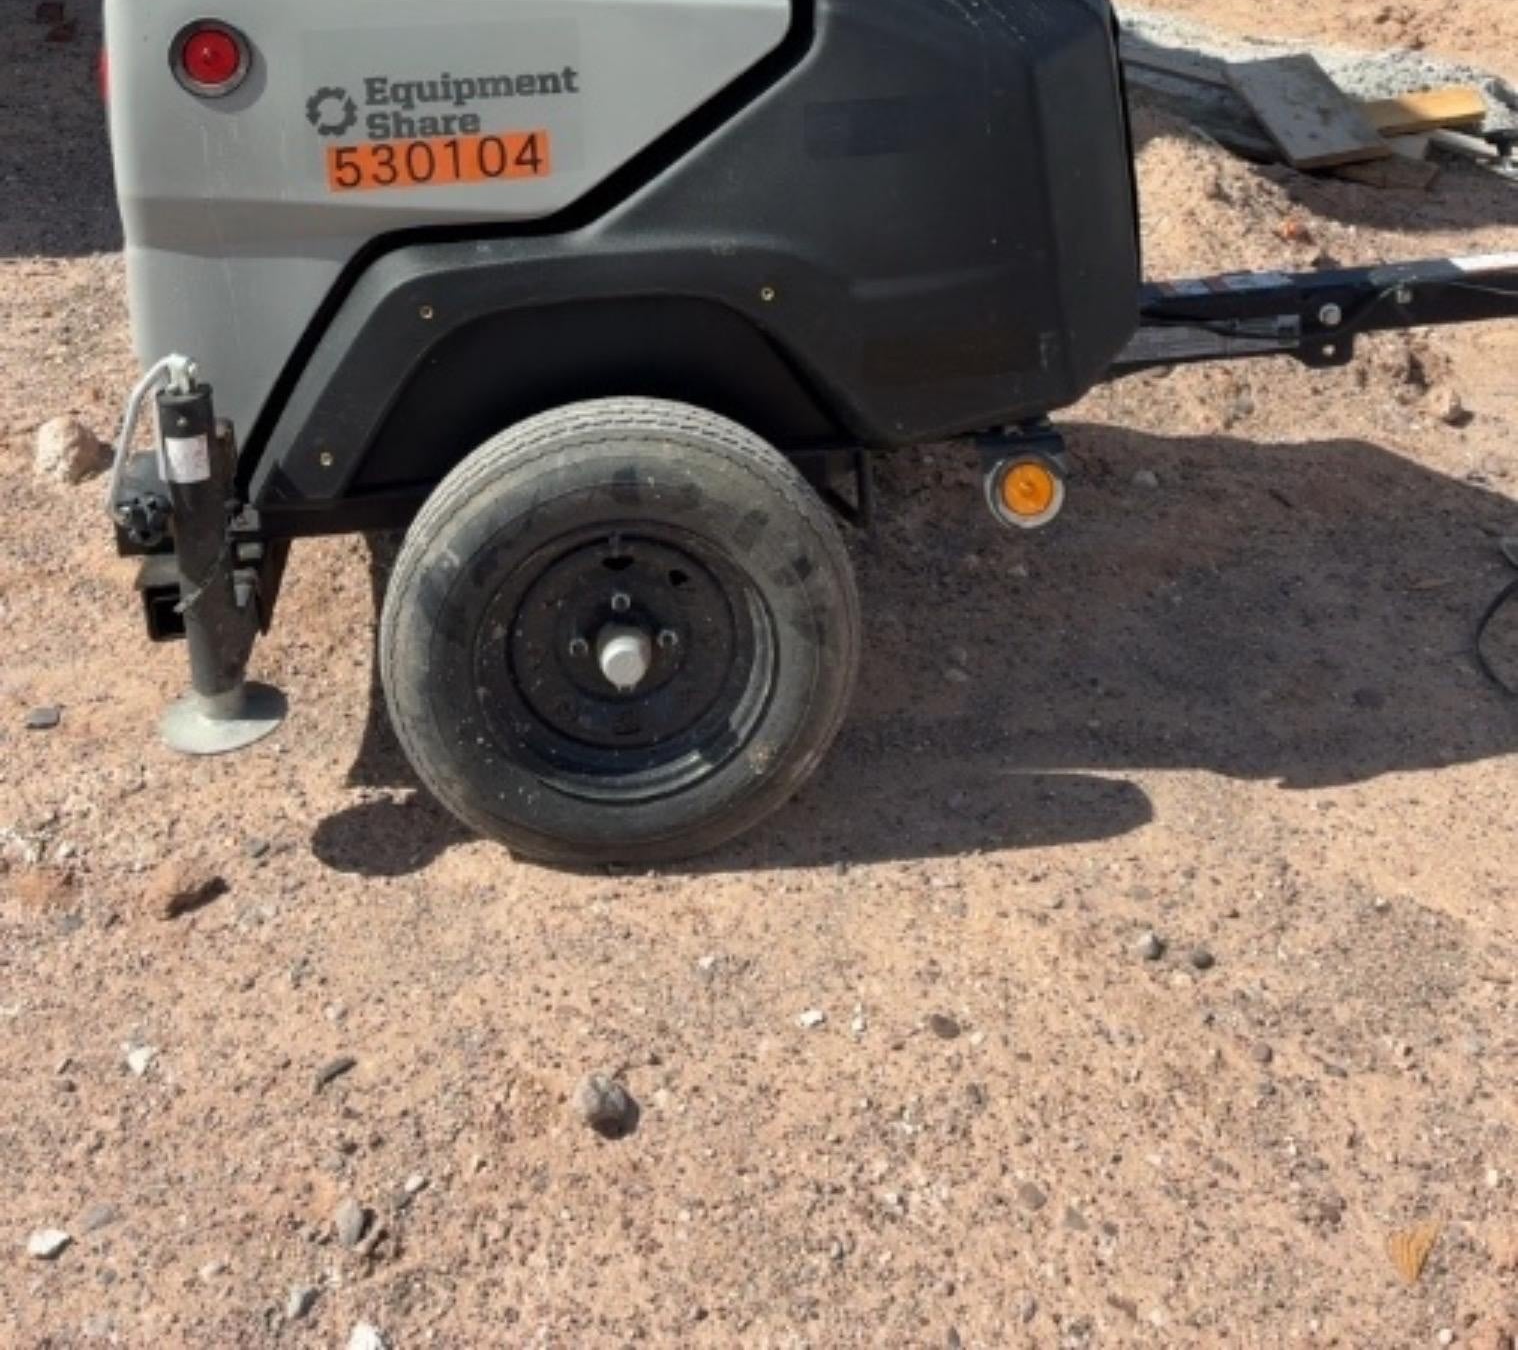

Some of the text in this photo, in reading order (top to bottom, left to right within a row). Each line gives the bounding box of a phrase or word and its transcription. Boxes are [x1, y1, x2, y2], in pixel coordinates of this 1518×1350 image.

[364, 67, 579, 108] Equipment
[366, 112, 480, 139] Share
[335, 134, 542, 188] 530104
